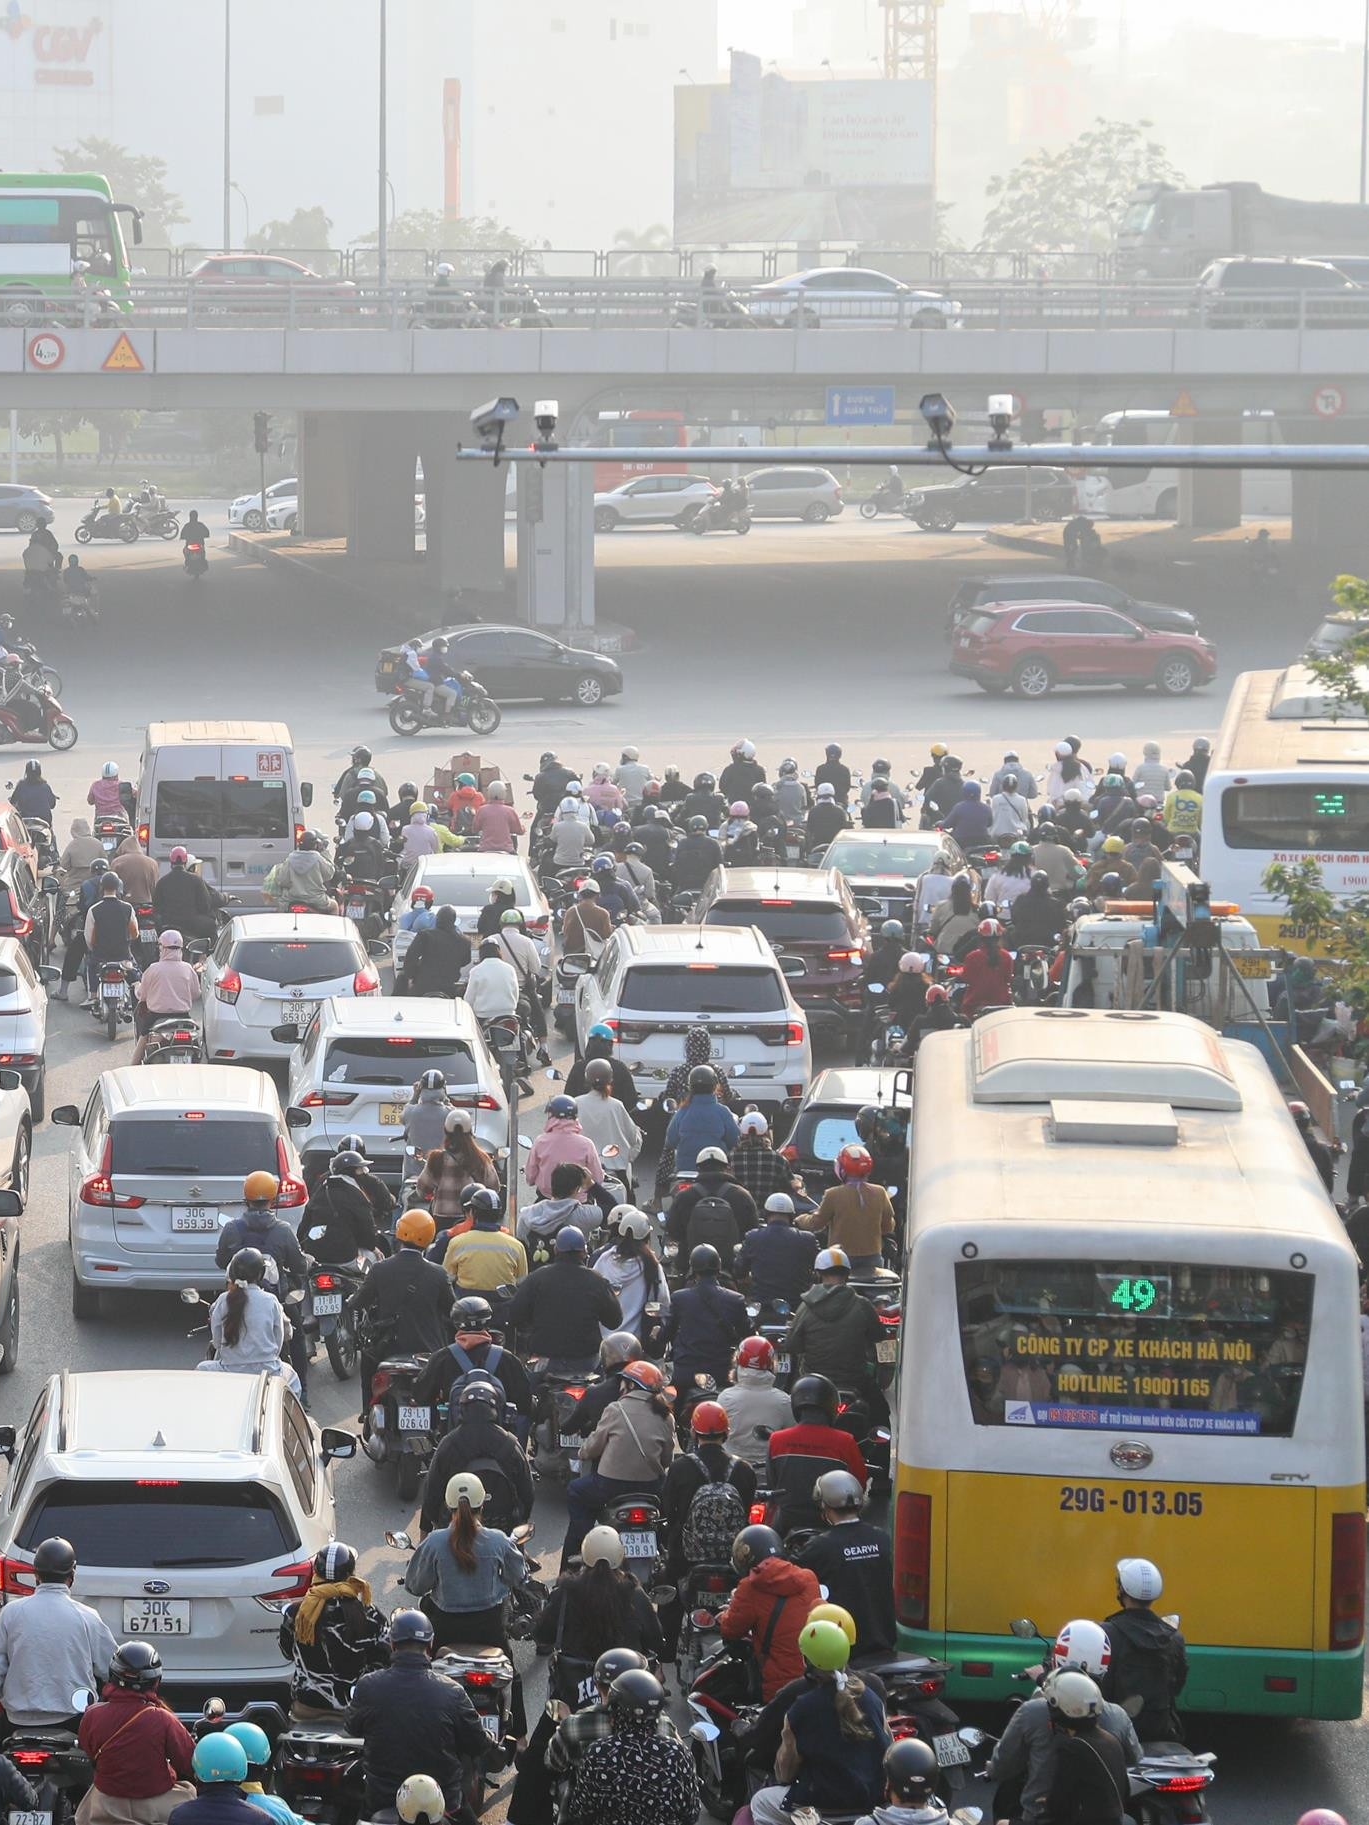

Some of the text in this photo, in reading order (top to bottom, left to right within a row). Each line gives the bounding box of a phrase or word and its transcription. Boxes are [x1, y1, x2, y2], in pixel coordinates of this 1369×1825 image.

[1175, 796, 1198, 812] be
[185, 1208, 205, 1218] 30G
[177, 1218, 214, 1229] 959.39
[1110, 1279, 1156, 1312] 49
[1017, 1333, 1252, 1365] CÔNG TY CP XE KHÁCH HÀ NỘI
[1058, 1373, 1210, 1397] HOTLINE: 19001165
[1122, 1411, 1141, 1425] THÀNH
[1205, 1418, 1214, 1429] XE
[1214, 1417, 1235, 1430] KHÁCH
[1060, 1487, 1105, 1512] 29G
[1122, 1490, 1203, 1516] 013.05
[844, 1544, 879, 1557] GEARVN
[142, 1602, 171, 1616] 30K
[130, 1618, 182, 1632] 671.51
